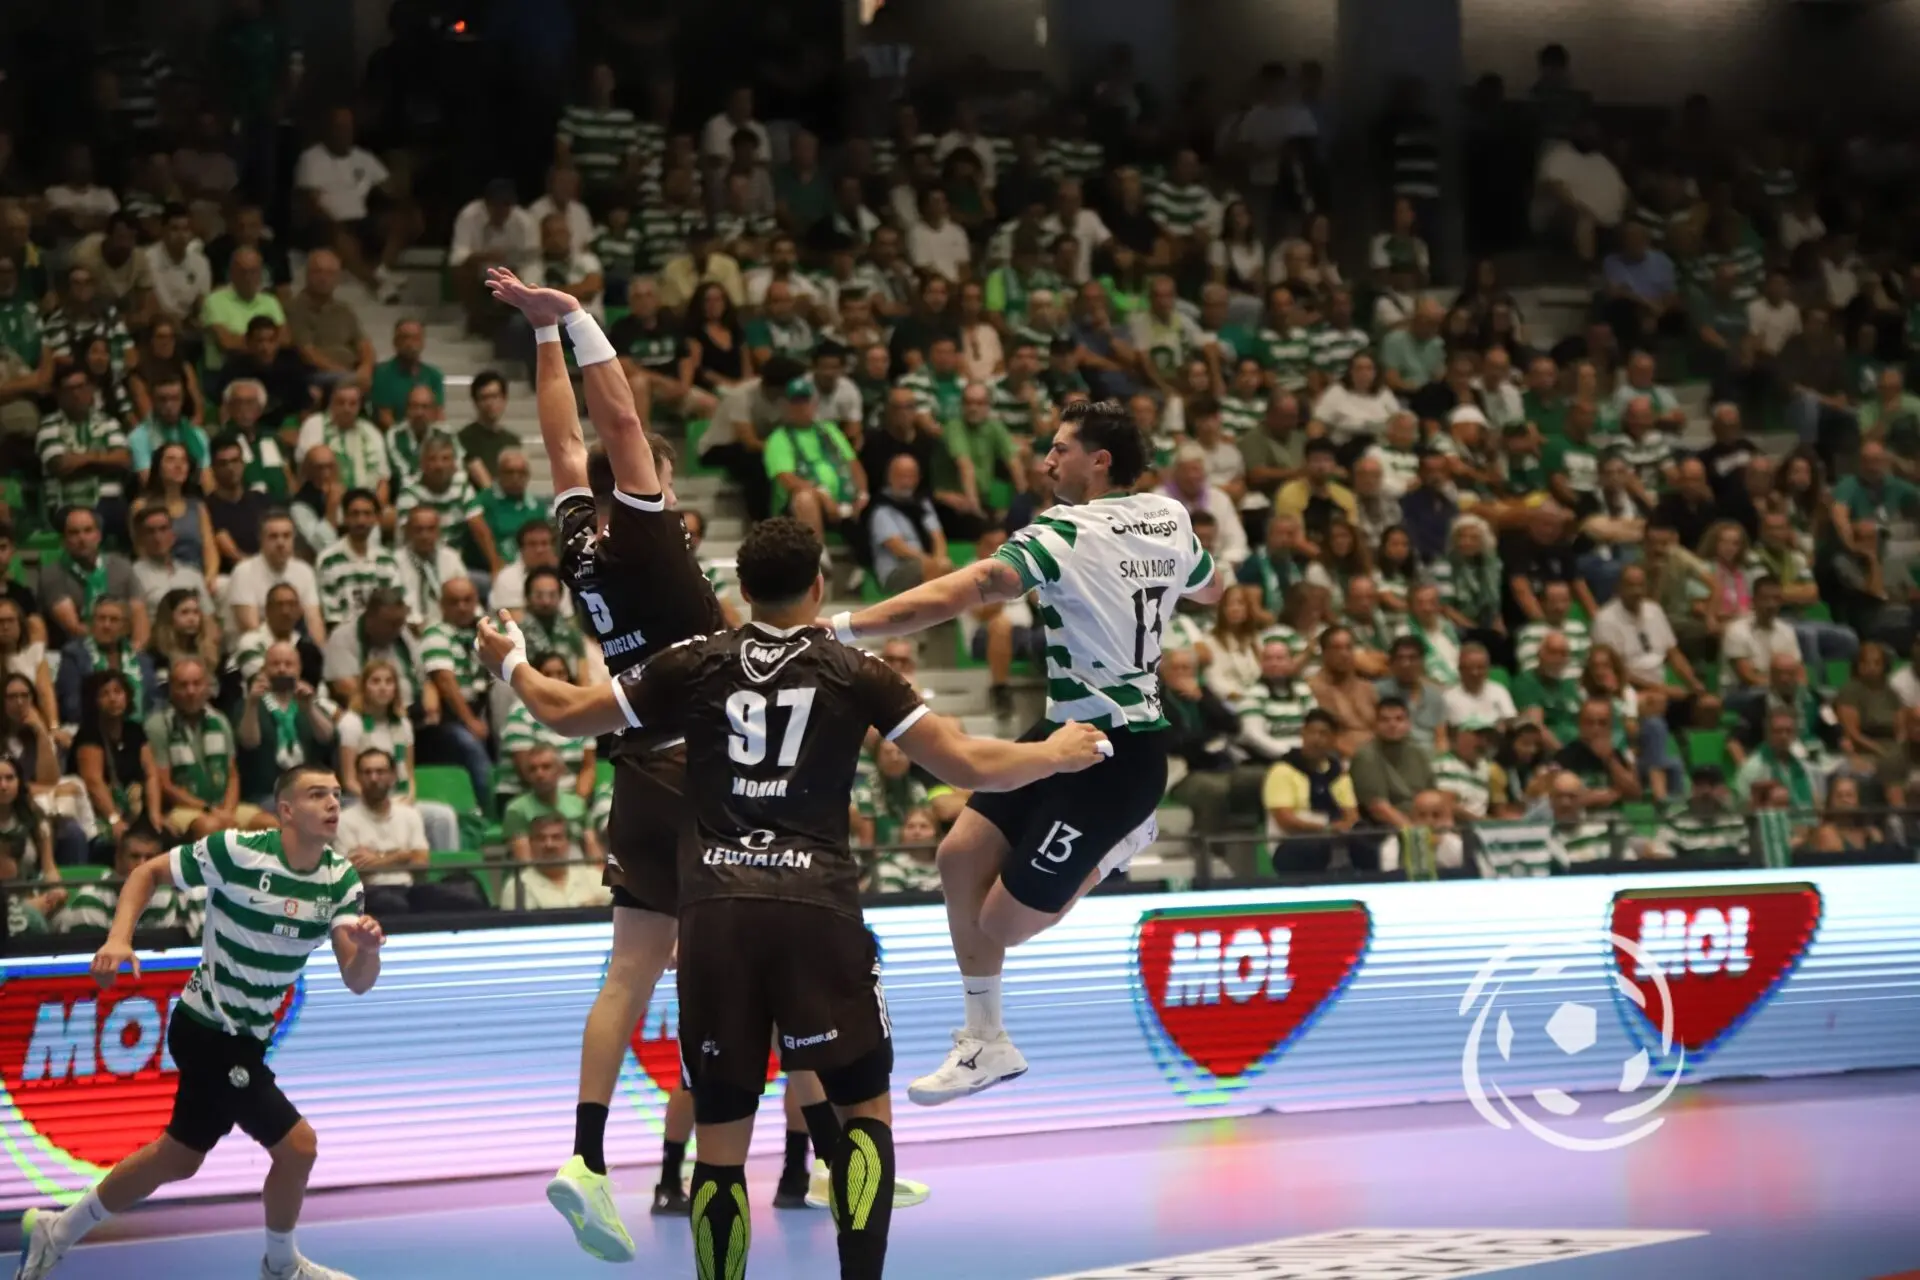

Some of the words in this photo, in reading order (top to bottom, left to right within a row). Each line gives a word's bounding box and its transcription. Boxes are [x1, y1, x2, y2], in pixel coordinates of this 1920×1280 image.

[1119, 559, 1176, 578] SALVADOR
[725, 687, 817, 766] 97
[1037, 820, 1083, 863] 13
[259, 872, 273, 893] 6
[1633, 906, 1752, 980] MOL
[1164, 926, 1295, 1008] MOL
[796, 1029, 838, 1047] FORBUILD
